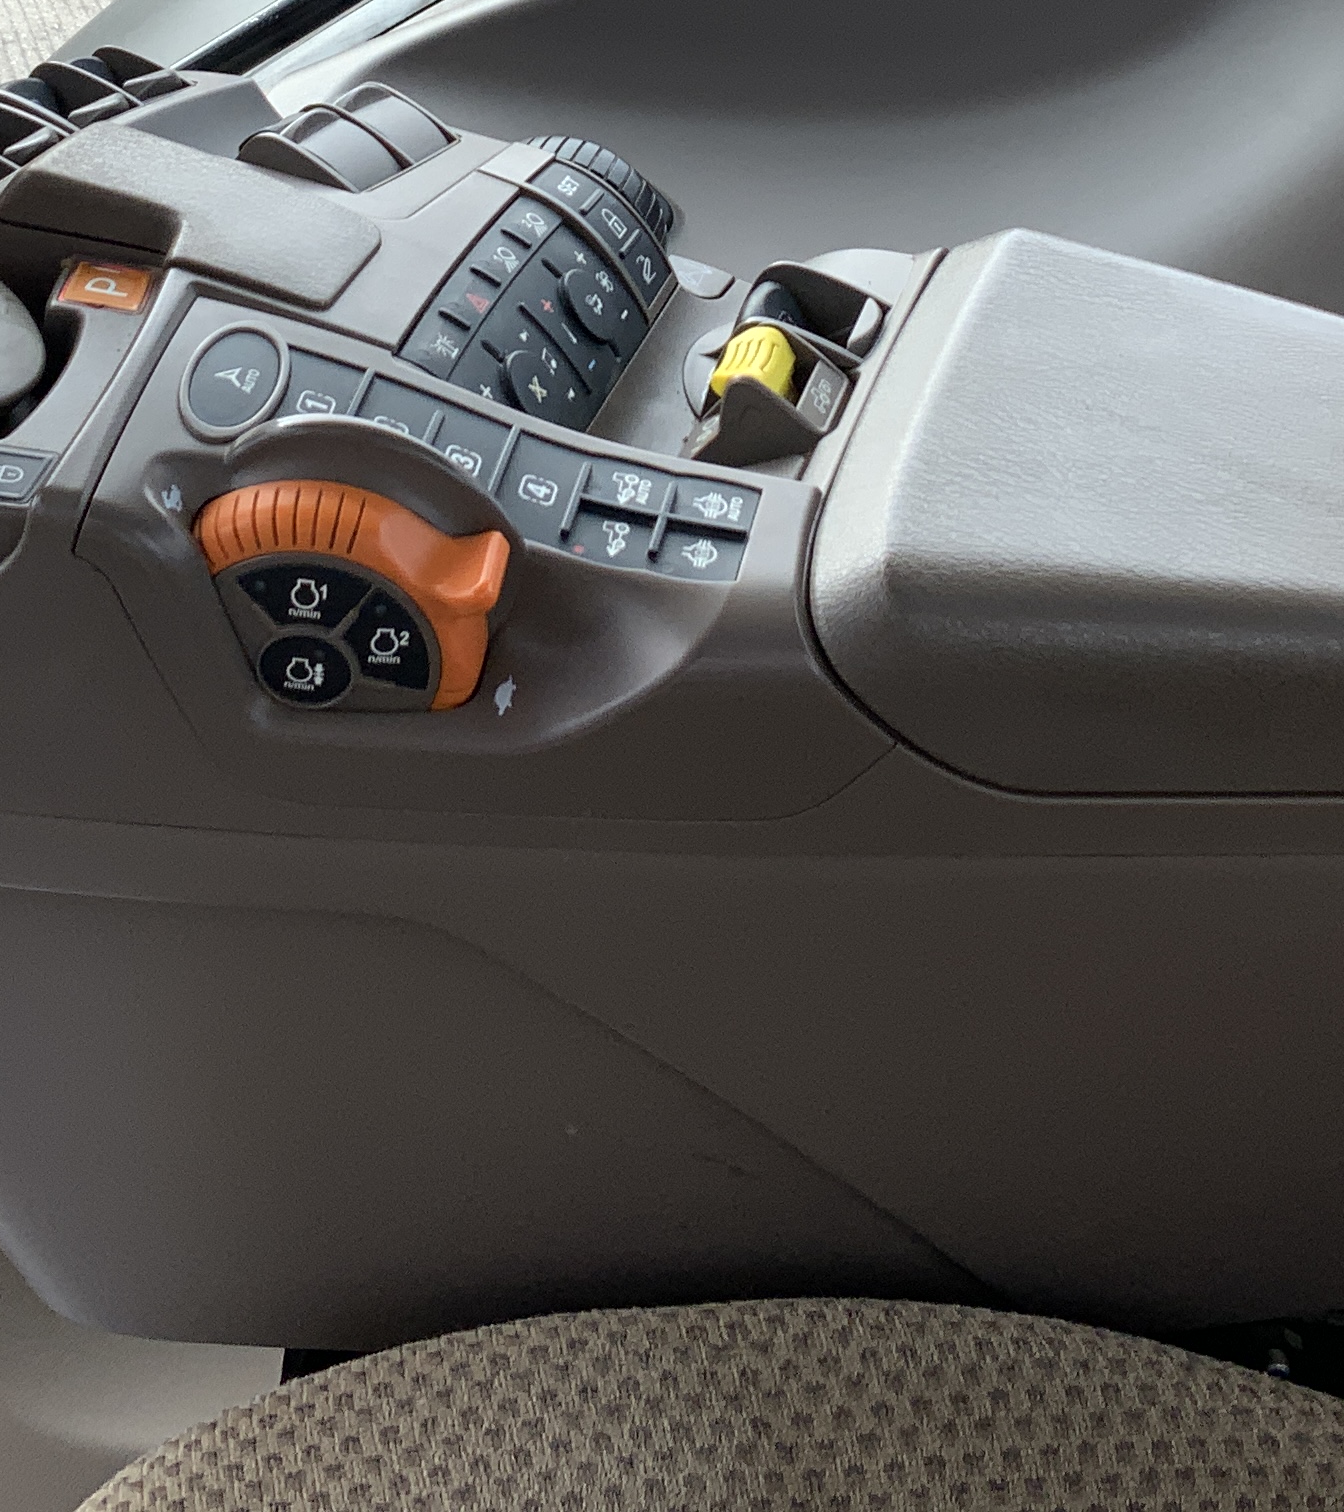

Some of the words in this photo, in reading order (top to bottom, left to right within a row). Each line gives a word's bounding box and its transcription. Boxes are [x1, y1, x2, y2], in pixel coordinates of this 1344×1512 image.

[84, 276, 129, 298] P
[241, 368, 261, 394] AUTO
[305, 398, 328, 410] 1
[526, 481, 551, 499] 4
[636, 479, 653, 506] AUTO
[727, 496, 744, 521] AUTO
[320, 584, 328, 601] 1
[288, 607, 321, 620] n/min
[400, 630, 410, 647] 2
[367, 654, 401, 665] n/min
[283, 680, 315, 692] n/min
